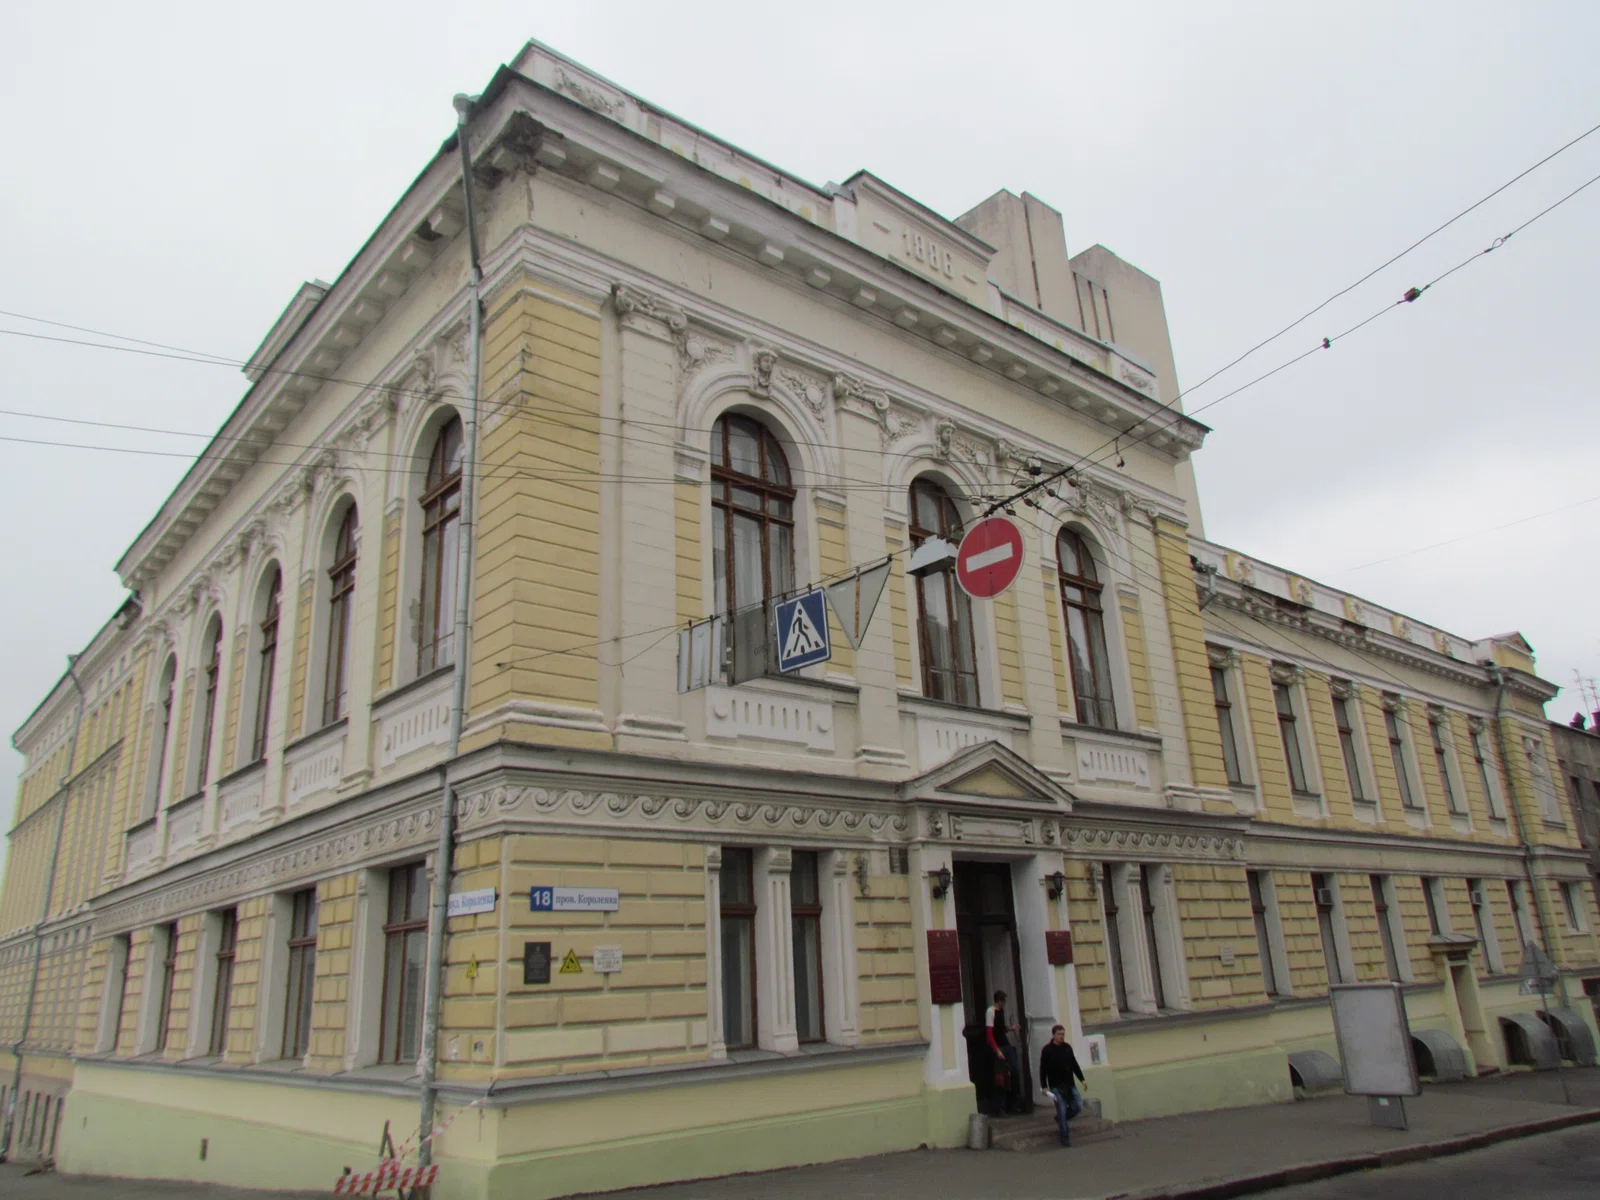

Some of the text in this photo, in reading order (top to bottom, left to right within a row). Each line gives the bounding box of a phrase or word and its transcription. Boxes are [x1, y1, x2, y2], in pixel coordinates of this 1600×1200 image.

[902, 228, 954, 280] 1886
[533, 890, 617, 906] 18 пров. Короленка
